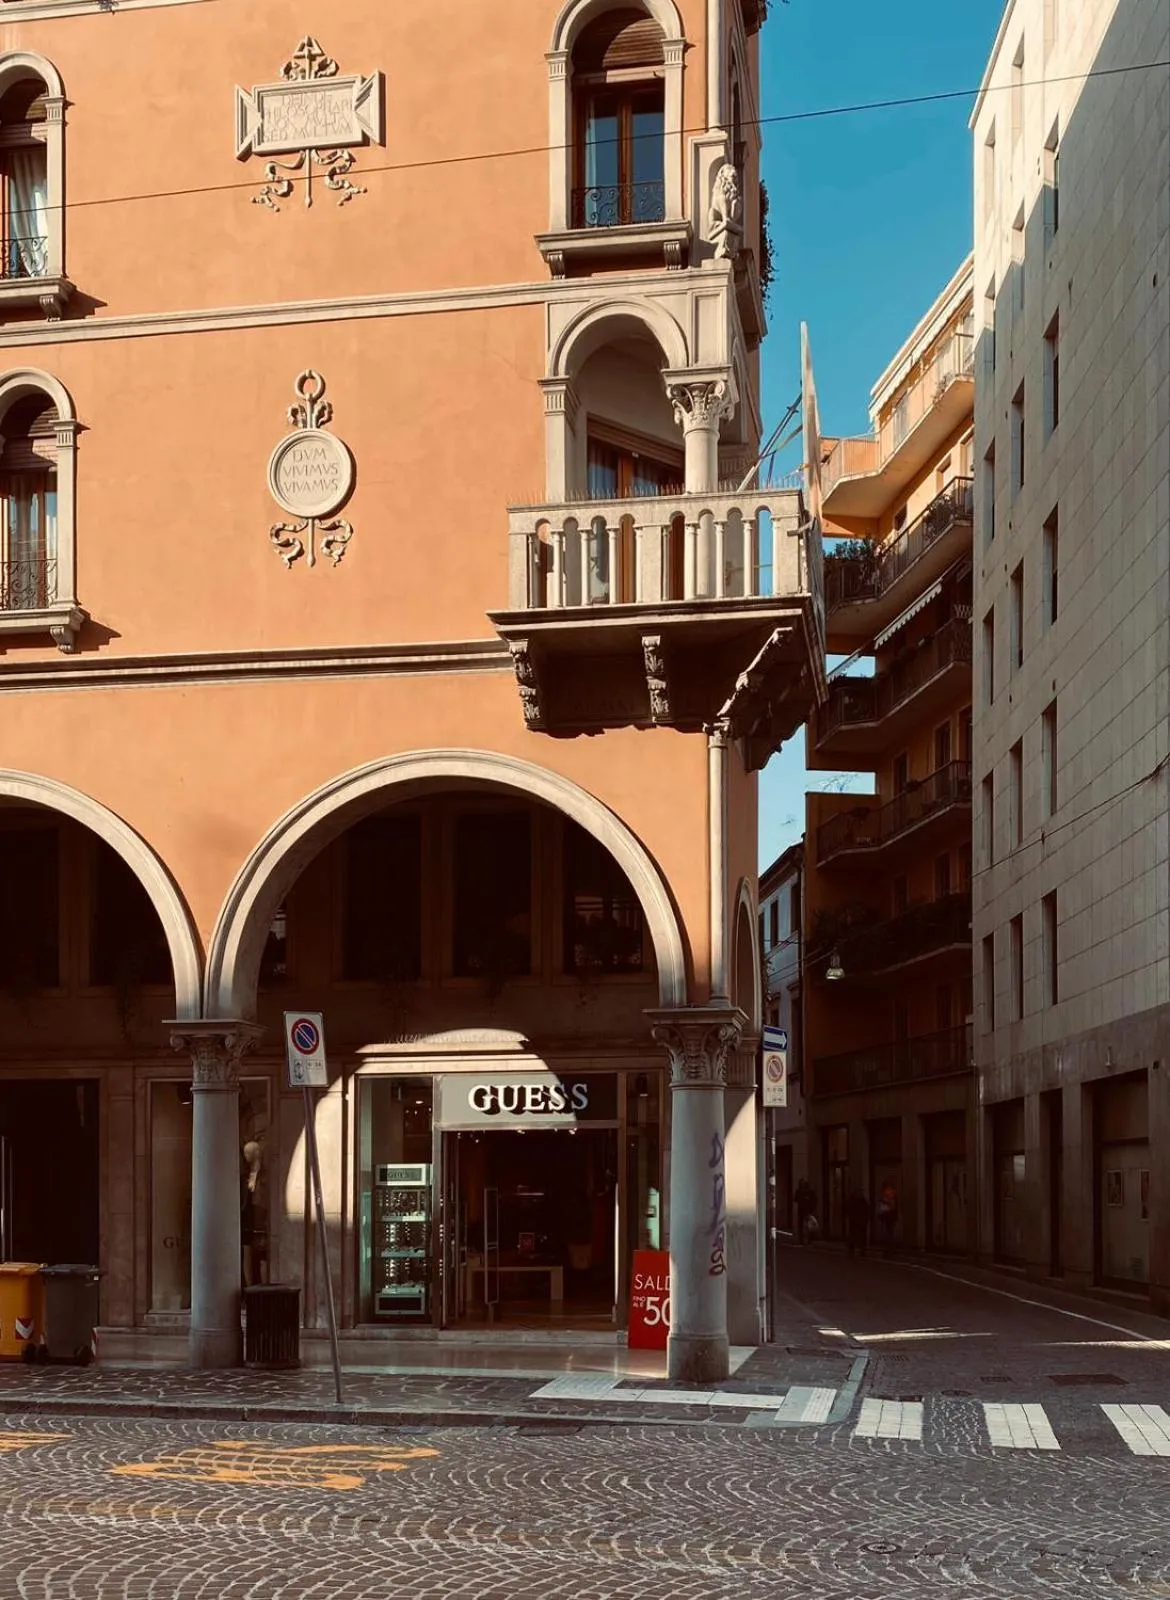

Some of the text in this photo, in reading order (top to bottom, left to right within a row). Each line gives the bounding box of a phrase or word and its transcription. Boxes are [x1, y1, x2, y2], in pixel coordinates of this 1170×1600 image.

[292, 447, 326, 462] DVM
[283, 462, 338, 478] VIVIMVS
[283, 478, 338, 493] VIVAMVS
[468, 1083, 588, 1111] GUESS
